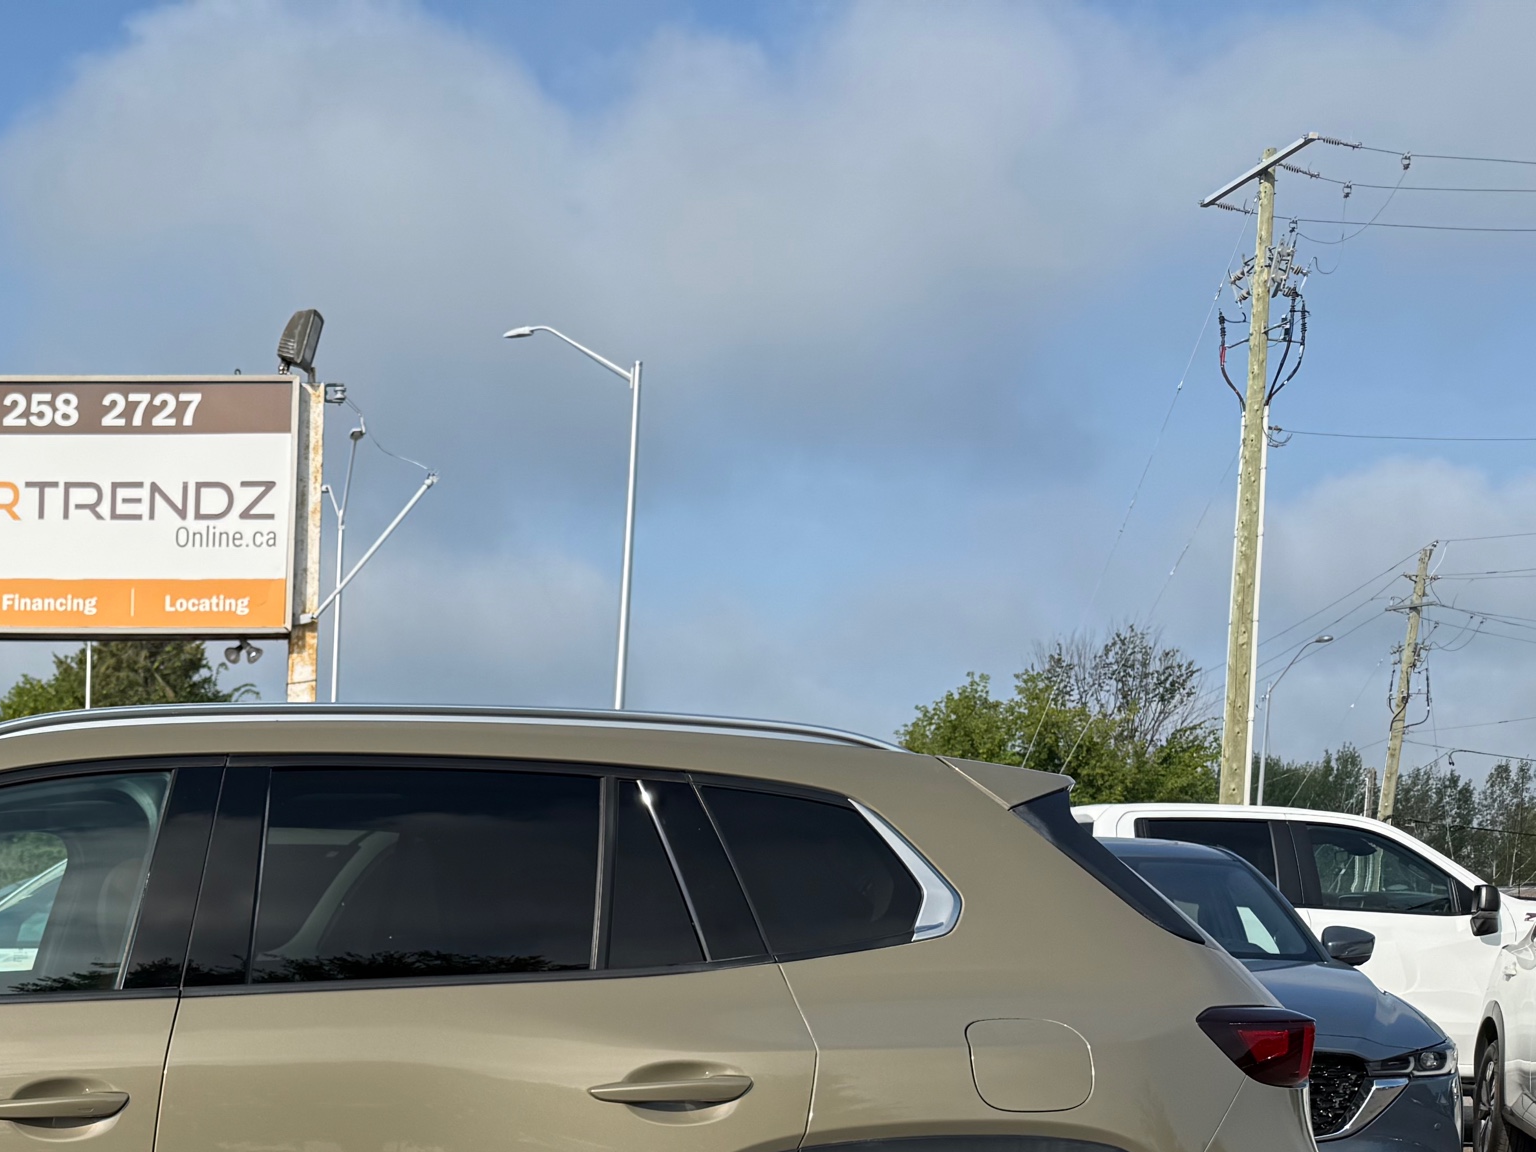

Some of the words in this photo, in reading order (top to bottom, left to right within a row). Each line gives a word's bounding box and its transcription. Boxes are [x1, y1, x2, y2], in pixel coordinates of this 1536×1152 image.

[2, 393, 79, 427] 258
[101, 393, 203, 427] 2727
[175, 525, 277, 548] Online.ca
[1, 593, 98, 615] Financing
[164, 594, 250, 616] Locating
